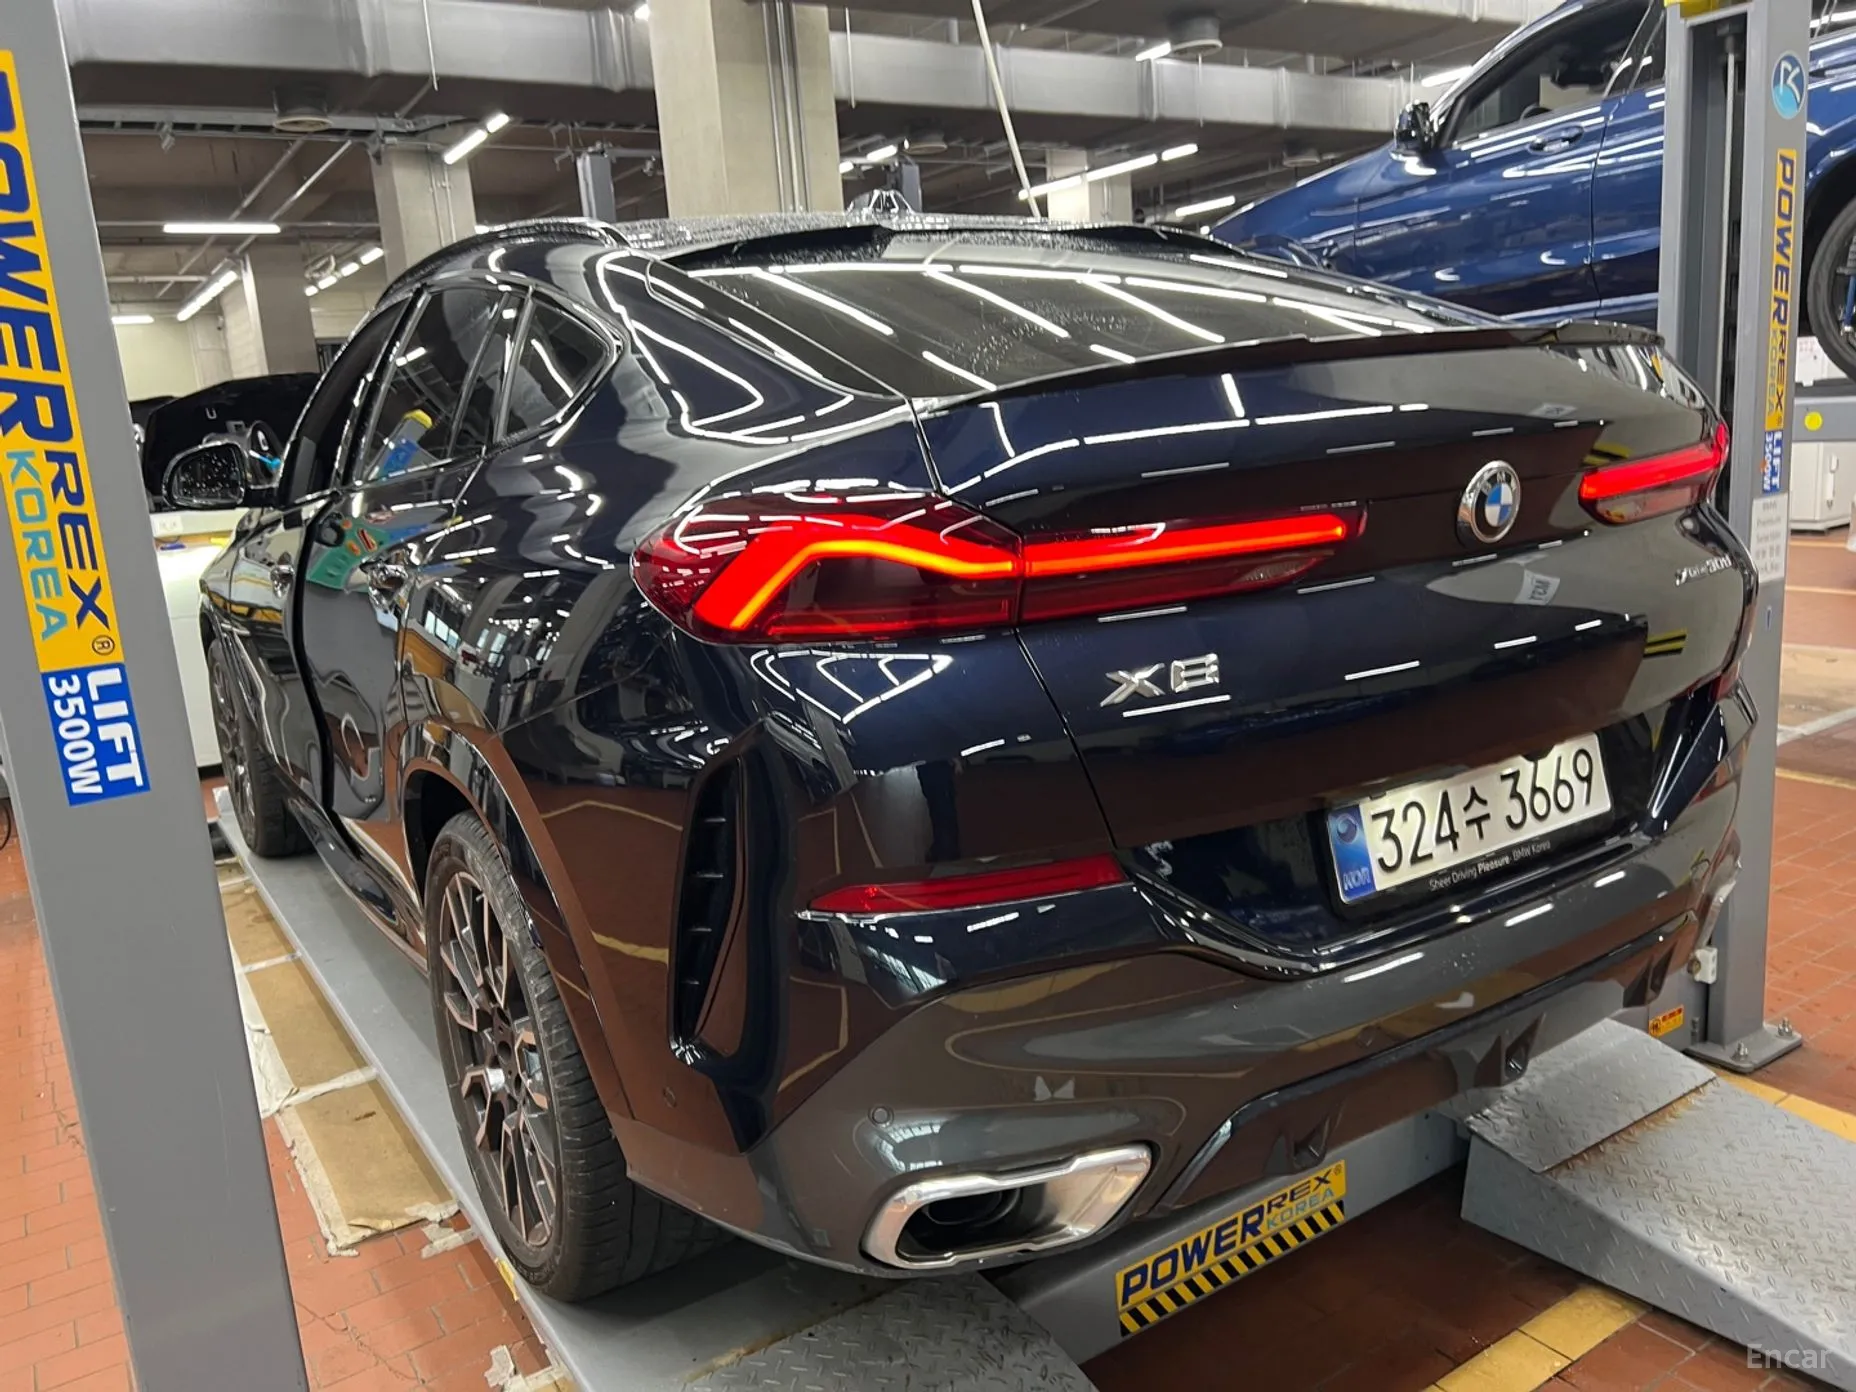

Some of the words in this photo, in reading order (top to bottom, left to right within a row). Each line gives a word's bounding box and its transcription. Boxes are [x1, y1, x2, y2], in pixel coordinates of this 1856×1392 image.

[1767, 328, 1779, 416] KOREA
[1771, 431, 1783, 490] LIFT
[6, 451, 68, 641] KOREA
[48, 674, 103, 797] 3500W
[86, 667, 144, 788] LIFT
[1371, 785, 1492, 874] 324수
[1500, 748, 1595, 830] 3669
[1343, 866, 1371, 891] KOR
[1429, 876, 1451, 892] Sheer
[1451, 867, 1478, 883] Driving
[1513, 845, 1531, 861] BMW
[1532, 840, 1551, 855] Korea
[1266, 1187, 1335, 1230] KOREA
